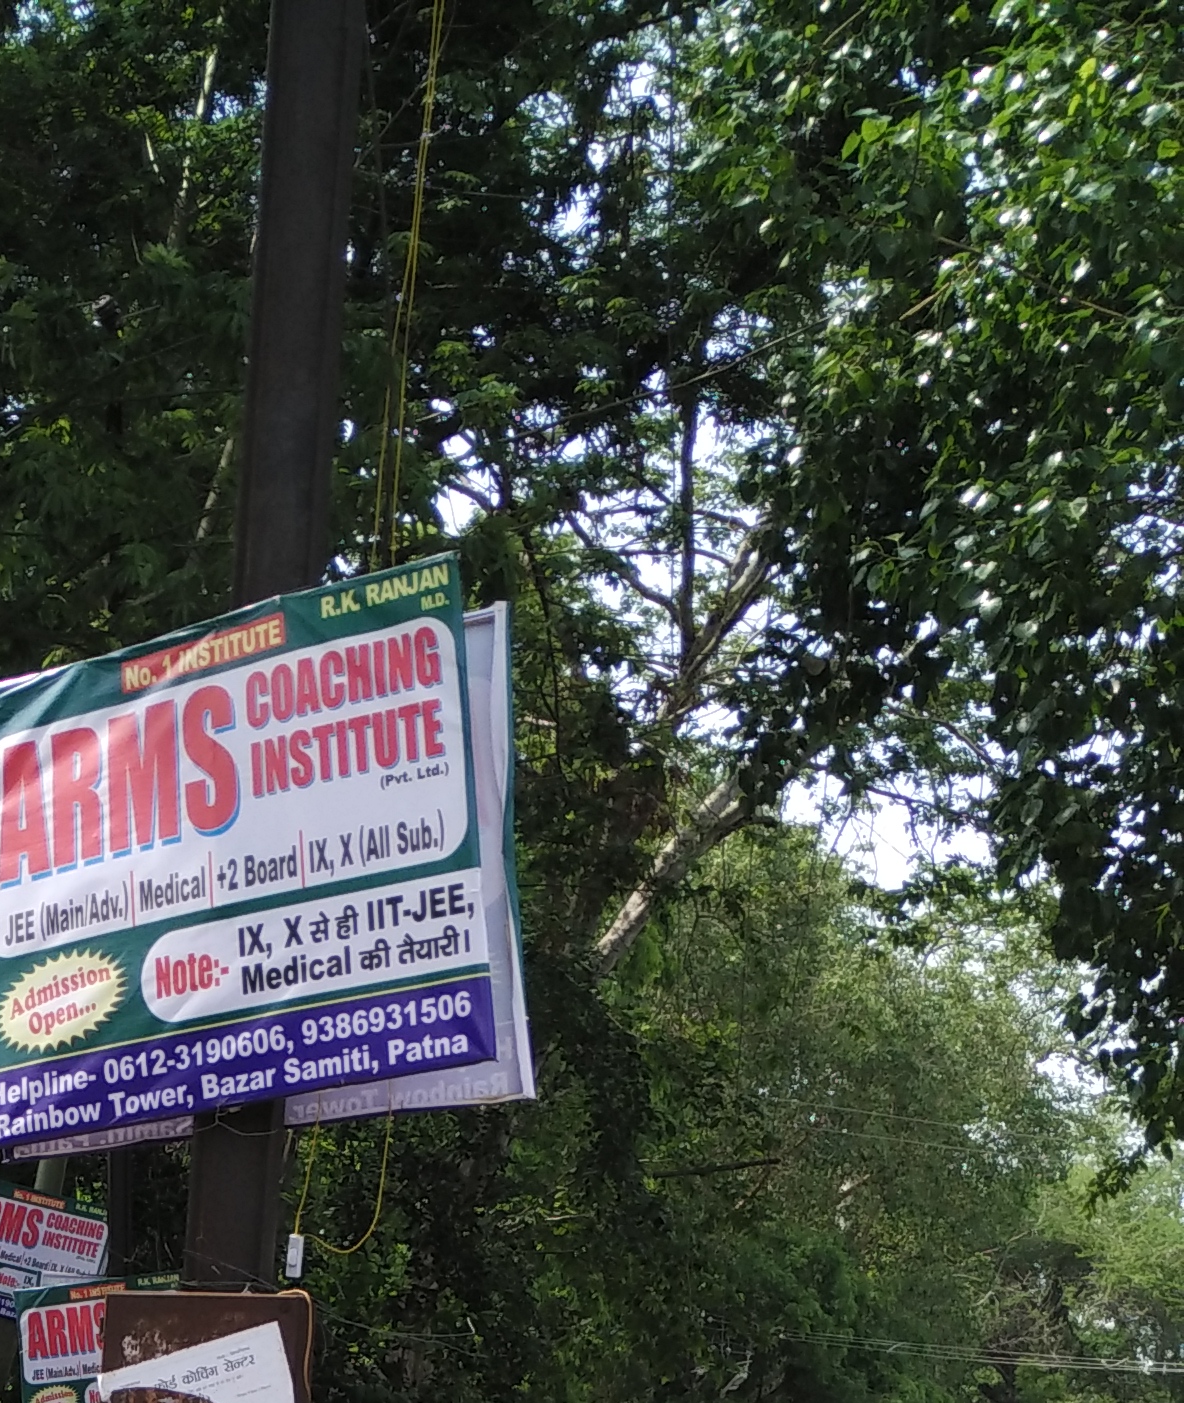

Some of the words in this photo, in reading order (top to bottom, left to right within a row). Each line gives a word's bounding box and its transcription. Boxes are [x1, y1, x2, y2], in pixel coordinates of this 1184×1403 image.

[320, 593, 361, 619] R.K.
[365, 563, 450, 607] RANJAN
[420, 592, 451, 611] M.D.
[123, 666, 158, 690] No.
[162, 660, 171, 678] 1
[178, 619, 283, 672] INSTITUTE
[245, 626, 444, 730] COACHING
[250, 698, 446, 798] INSTITUTE
[379, 772, 413, 790] (Pvt.
[416, 761, 450, 780] Ltd.)
[4, 909, 36, 946] JEE
[39, 880, 129, 941] (Main/Adv.)
[139, 865, 206, 913] Medical
[216, 858, 238, 891] +2
[244, 844, 298, 888] Board
[308, 837, 335, 876] IX,
[339, 832, 355, 868] X
[358, 824, 392, 867] (All
[396, 808, 445, 856] Sub.)
[237, 923, 272, 960] IX,
[283, 914, 304, 949] X
[308, 911, 330, 945] से
[334, 904, 360, 940] ही
[366, 882, 475, 932] IIT-JEE,
[9, 966, 112, 1021] Admission
[154, 952, 230, 1000] Note:-
[241, 944, 352, 996] Medical
[358, 938, 391, 972] की
[102, 1024, 295, 1086] 0612-3190606,
[301, 990, 472, 1047] 9386931506
[108, 1077, 194, 1117] Tower,
[200, 1065, 281, 1099] Bazar
[283, 1046, 380, 1087] Samiti,
[387, 1031, 469, 1066] Patna
[41, 1230, 100, 1258] INSTITUTE
[46, 1212, 104, 1240] COACHING
[32, 1367, 44, 1381] JEE
[82, 1361, 101, 1375] Medic
